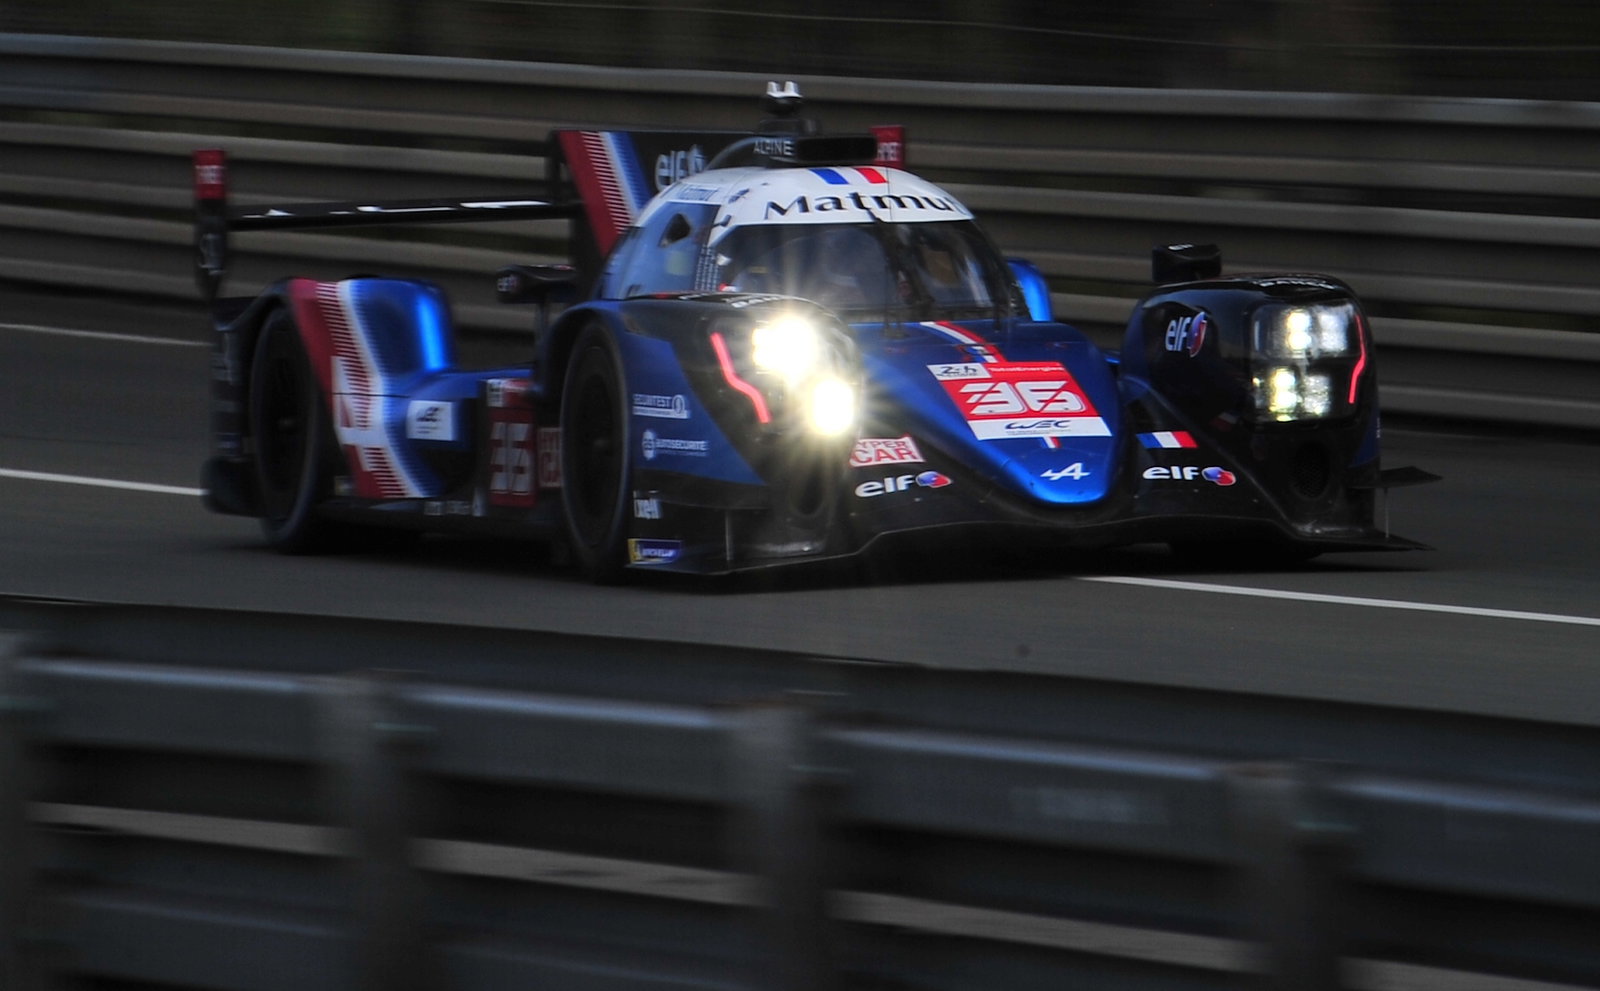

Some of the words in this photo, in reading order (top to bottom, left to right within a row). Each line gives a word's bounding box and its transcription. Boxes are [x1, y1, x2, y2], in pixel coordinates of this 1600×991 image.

[753, 141, 795, 156] ALPINE
[1165, 316, 1192, 351] elf
[958, 380, 1086, 416] 36
[1005, 419, 1072, 430] WEC
[852, 447, 918, 464] CAR
[1142, 465, 1200, 480] elf
[854, 474, 916, 498] elf
